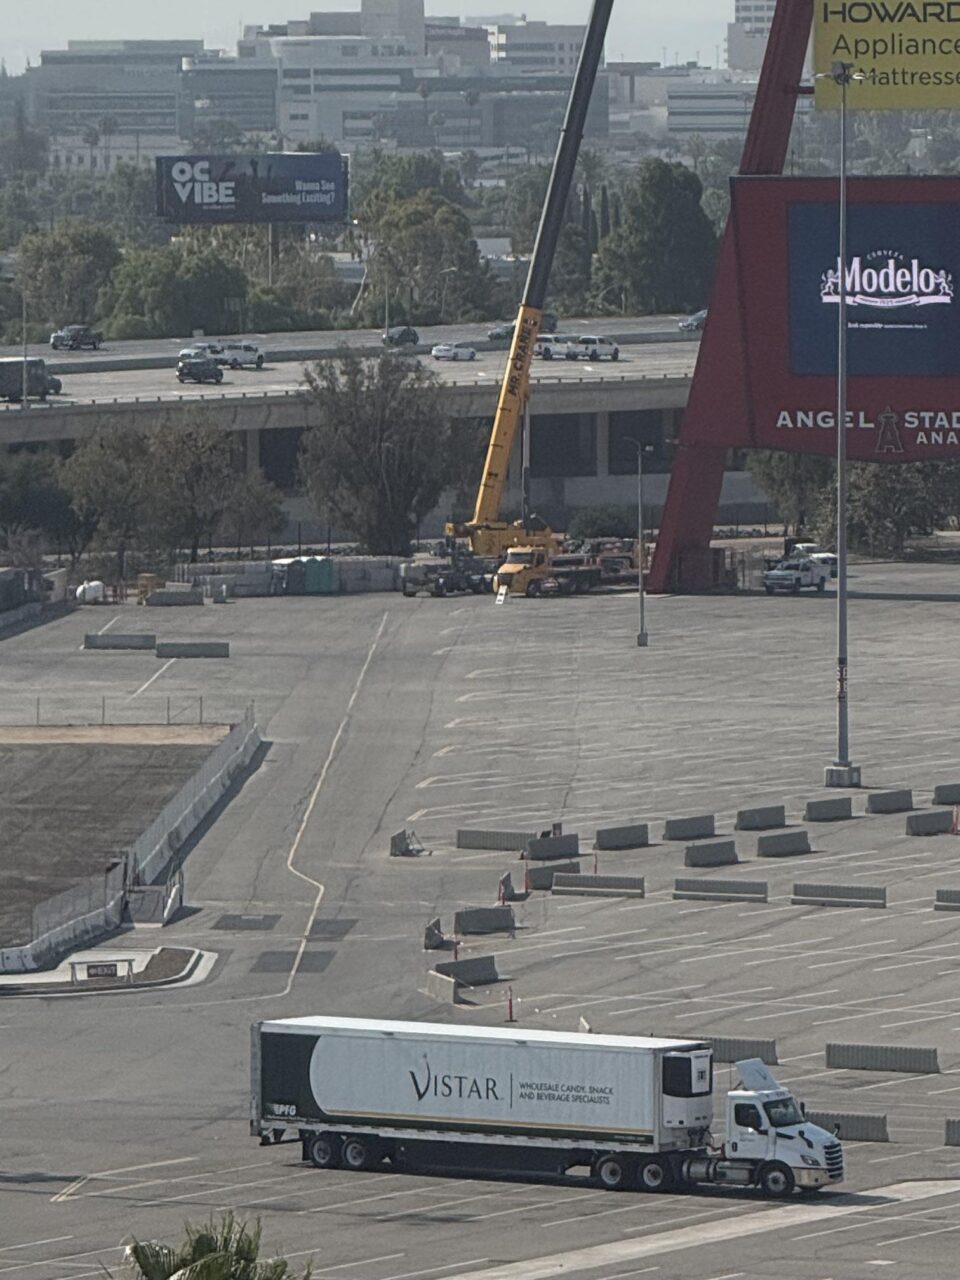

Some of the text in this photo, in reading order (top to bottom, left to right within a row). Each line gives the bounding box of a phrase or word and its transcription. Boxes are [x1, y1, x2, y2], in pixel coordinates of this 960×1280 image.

[171, 161, 210, 182] OC
[173, 181, 236, 204] VIBE
[295, 180, 335, 191] Wanna See
[262, 192, 335, 205] Something Exciting?
[837, 256, 936, 293] Modelo
[513, 326, 531, 372] CRANE
[776, 411, 875, 428] ANGEL
[408, 1053, 500, 1101] VISTAR
[519, 1081, 560, 1092] WHOLESALE
[588, 1086, 614, 1095] SNACK
[519, 1091, 611, 1105] AND BEVERAGE SPECIALISTS
[279, 1104, 297, 1116] PFG
